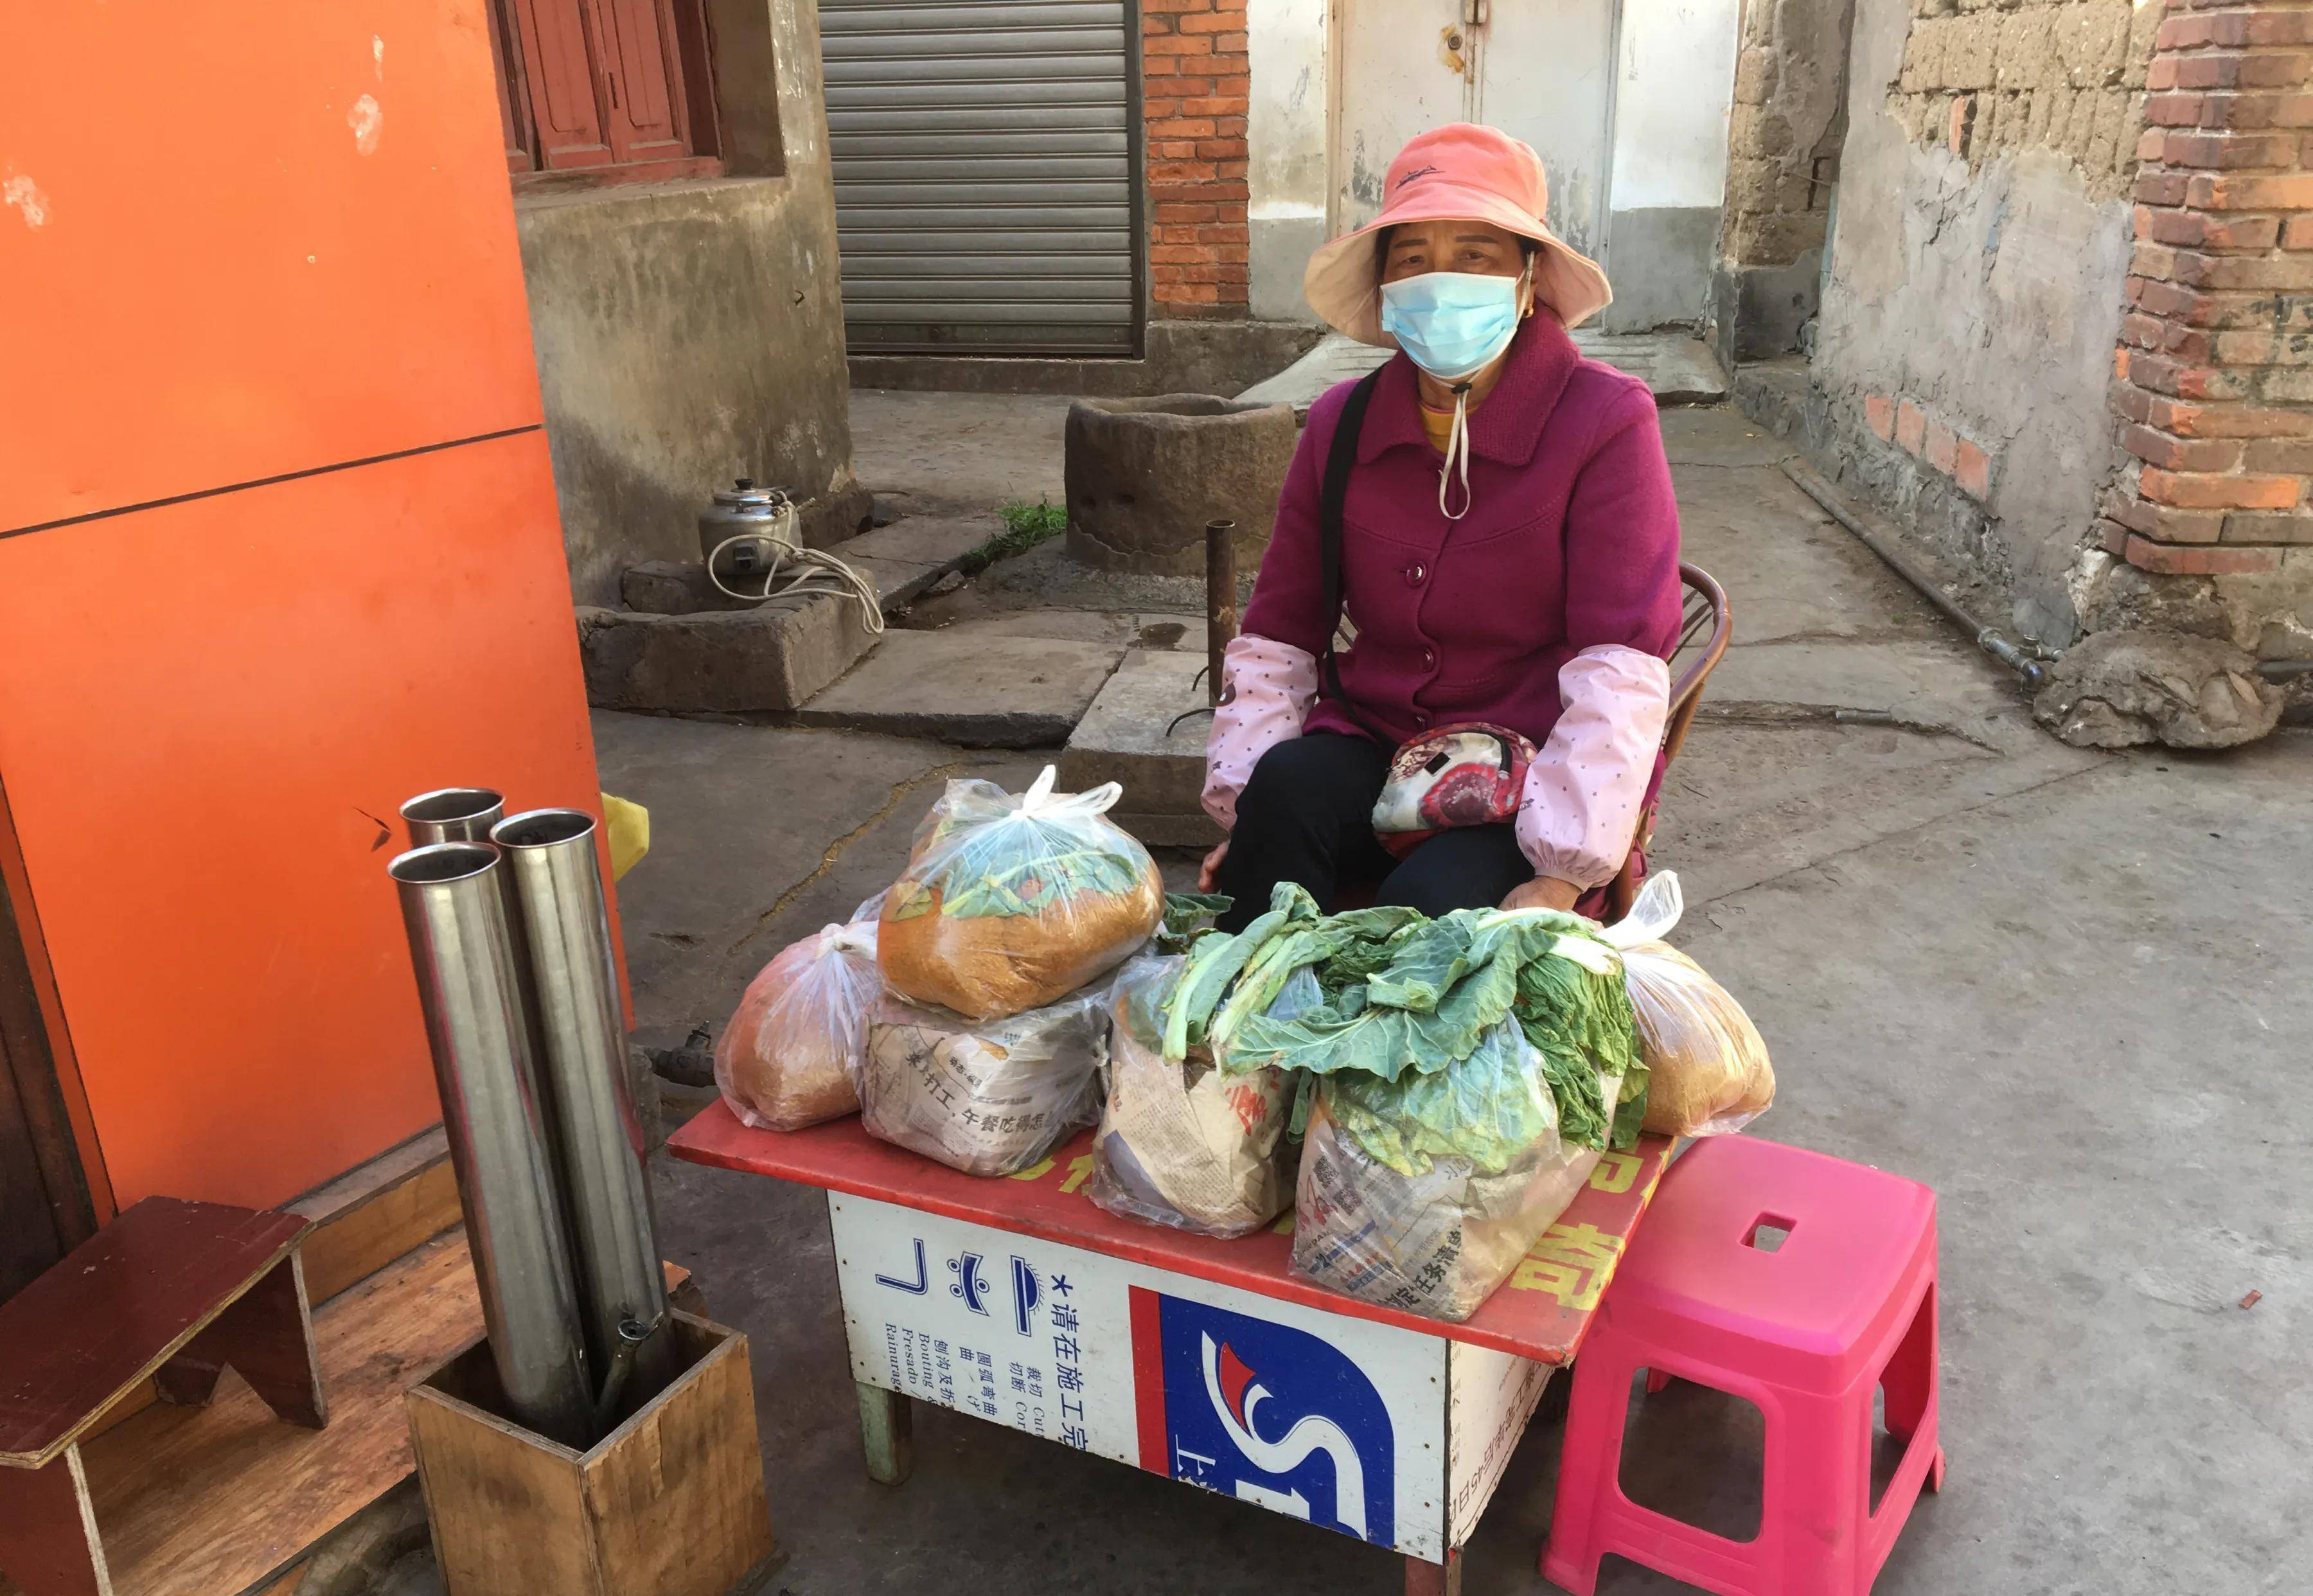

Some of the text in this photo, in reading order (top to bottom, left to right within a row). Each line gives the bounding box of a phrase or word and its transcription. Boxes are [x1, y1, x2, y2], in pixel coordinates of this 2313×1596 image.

[901, 1326, 917, 1384] Fresado
[917, 1333, 936, 1389] Bouting
[1027, 1367, 1043, 1397] 裁切
[1008, 1362, 1029, 1432] 切断 Cor
[1174, 1433, 1218, 1492] 上
